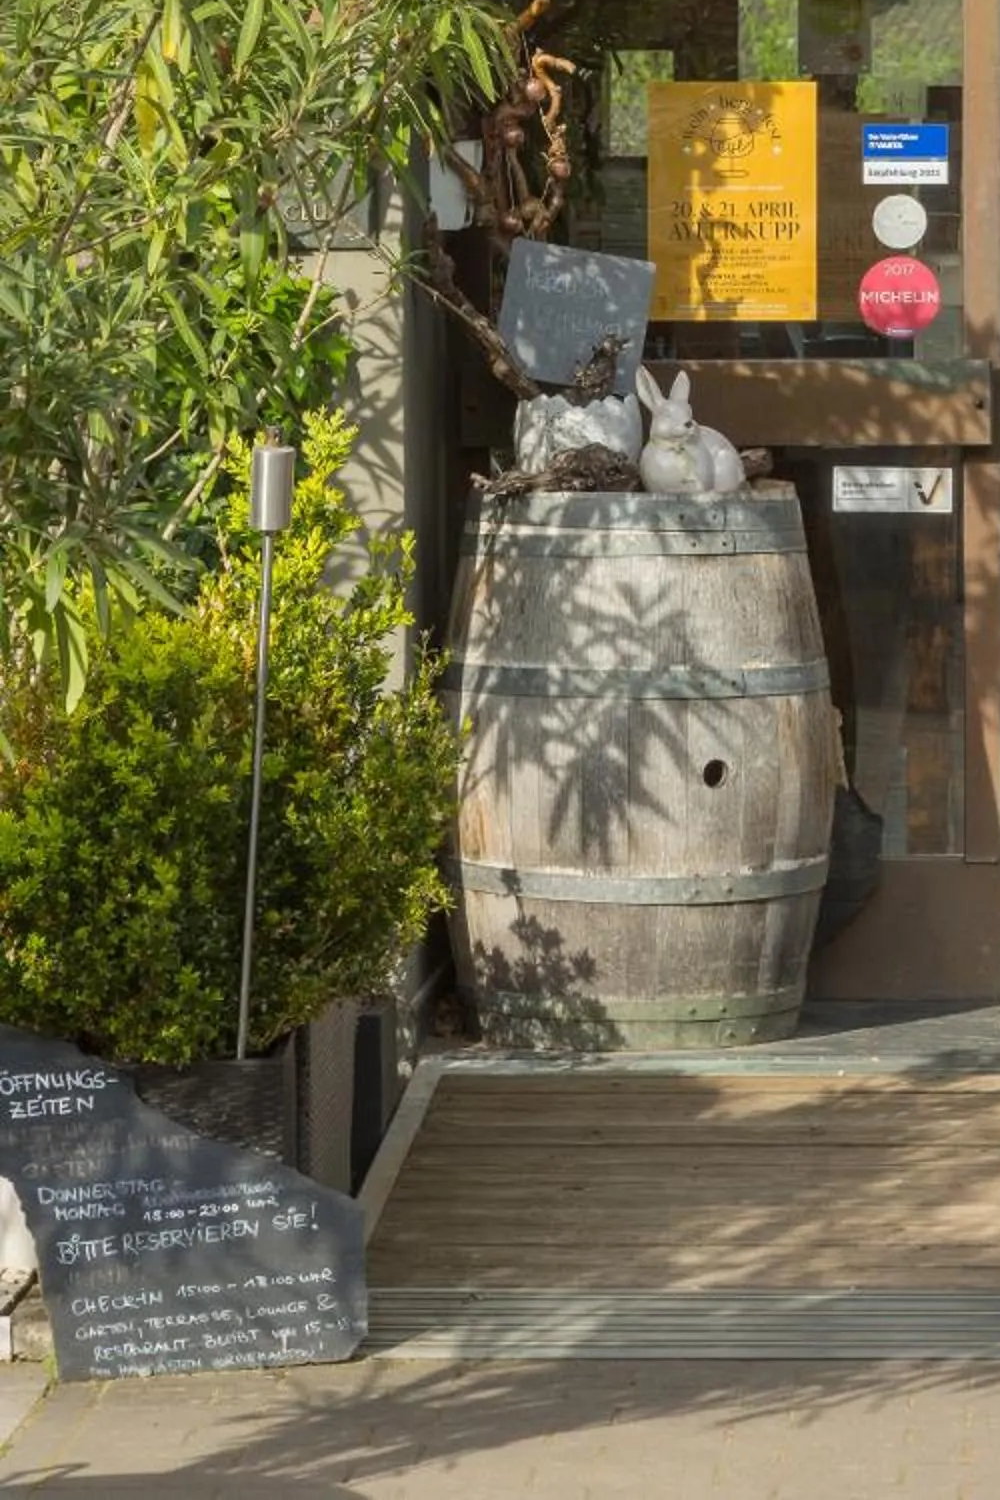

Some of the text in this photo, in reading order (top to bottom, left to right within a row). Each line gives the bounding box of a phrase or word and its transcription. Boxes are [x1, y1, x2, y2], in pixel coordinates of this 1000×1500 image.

[700, 202, 715, 218] &
[748, 201, 799, 218] APRIL
[883, 263, 915, 276] 2017
[861, 291, 939, 304] MICHELIN
[315, 1293, 338, 1311] &
